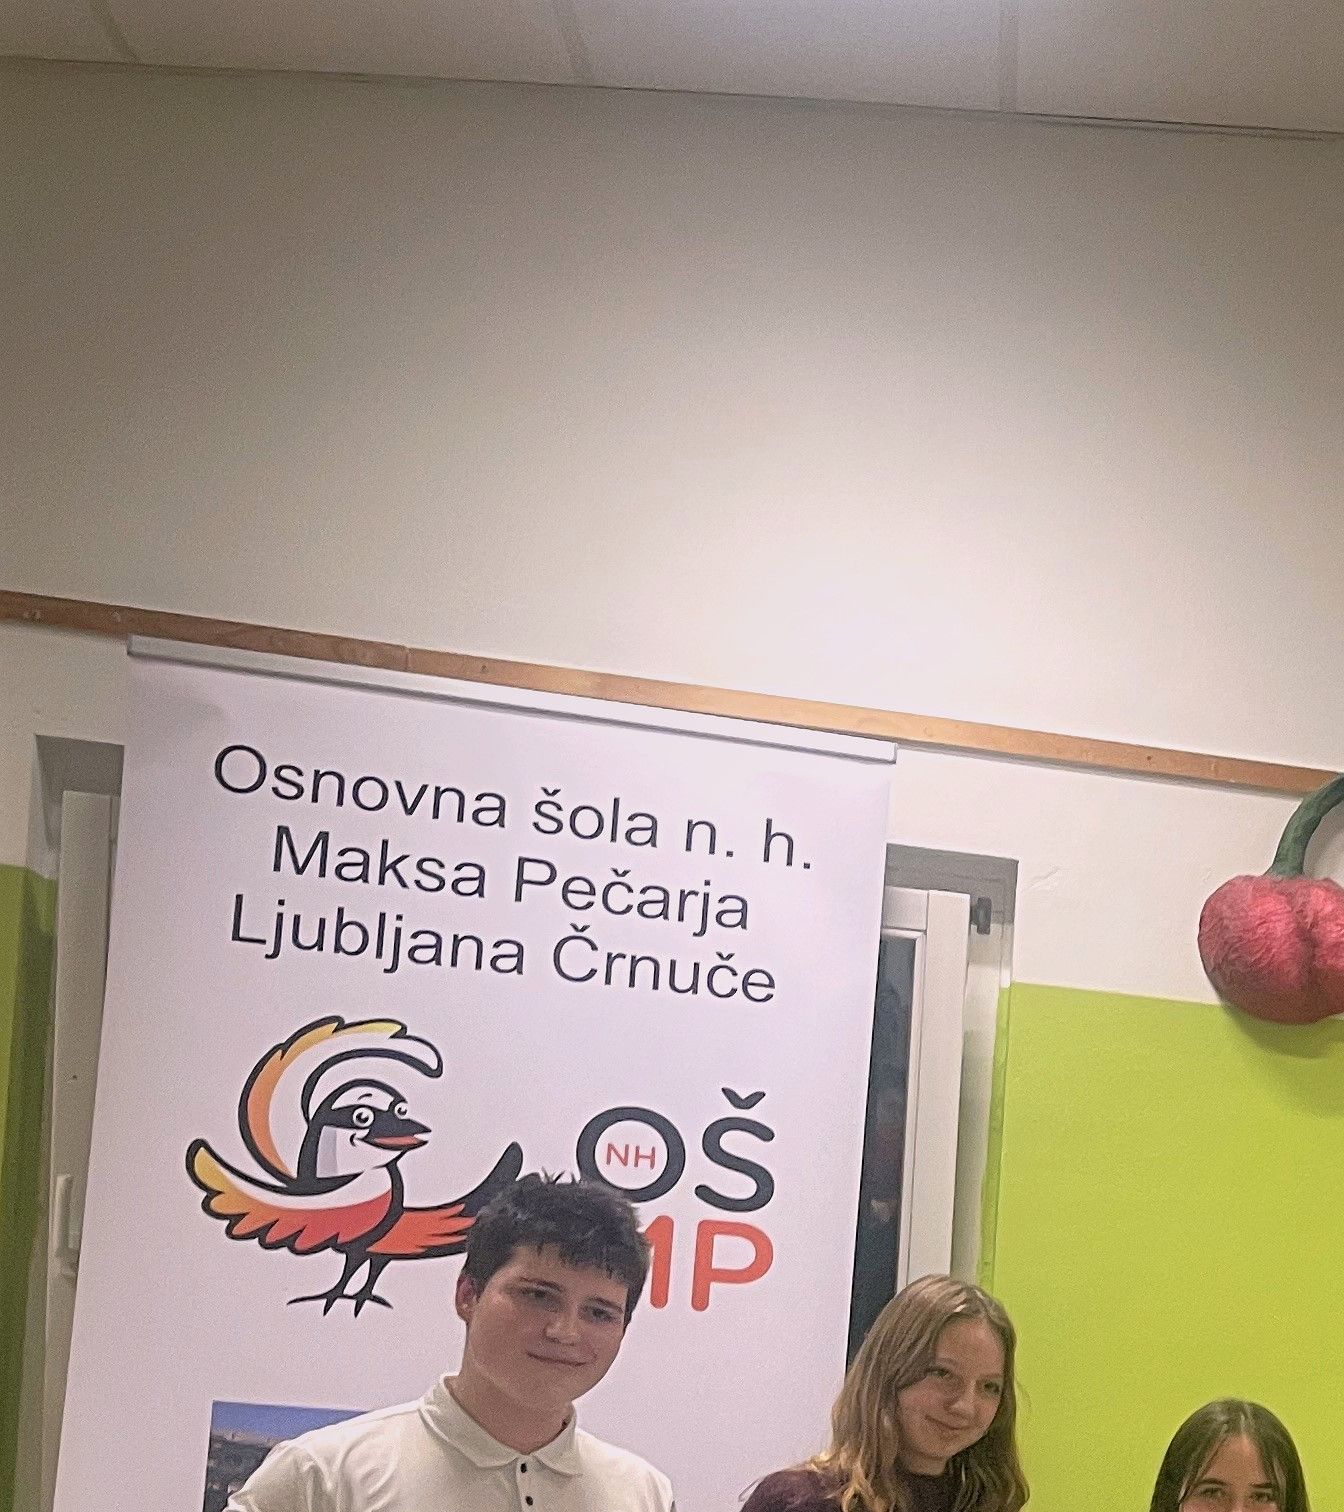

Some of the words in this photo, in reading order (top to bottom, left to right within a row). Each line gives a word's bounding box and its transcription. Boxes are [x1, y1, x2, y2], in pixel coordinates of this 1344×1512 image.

[214, 744, 506, 828] Osnovna
[532, 786, 658, 849] šola
[685, 818, 734, 858] n.
[763, 817, 811, 870] h.
[272, 825, 487, 898] Maksa
[514, 855, 749, 938] Pečarja
[231, 893, 525, 975] Ljubljana
[553, 922, 776, 1003] Črnuče
[576, 1086, 776, 1213] OŠ
[606, 1142, 657, 1170] NH
